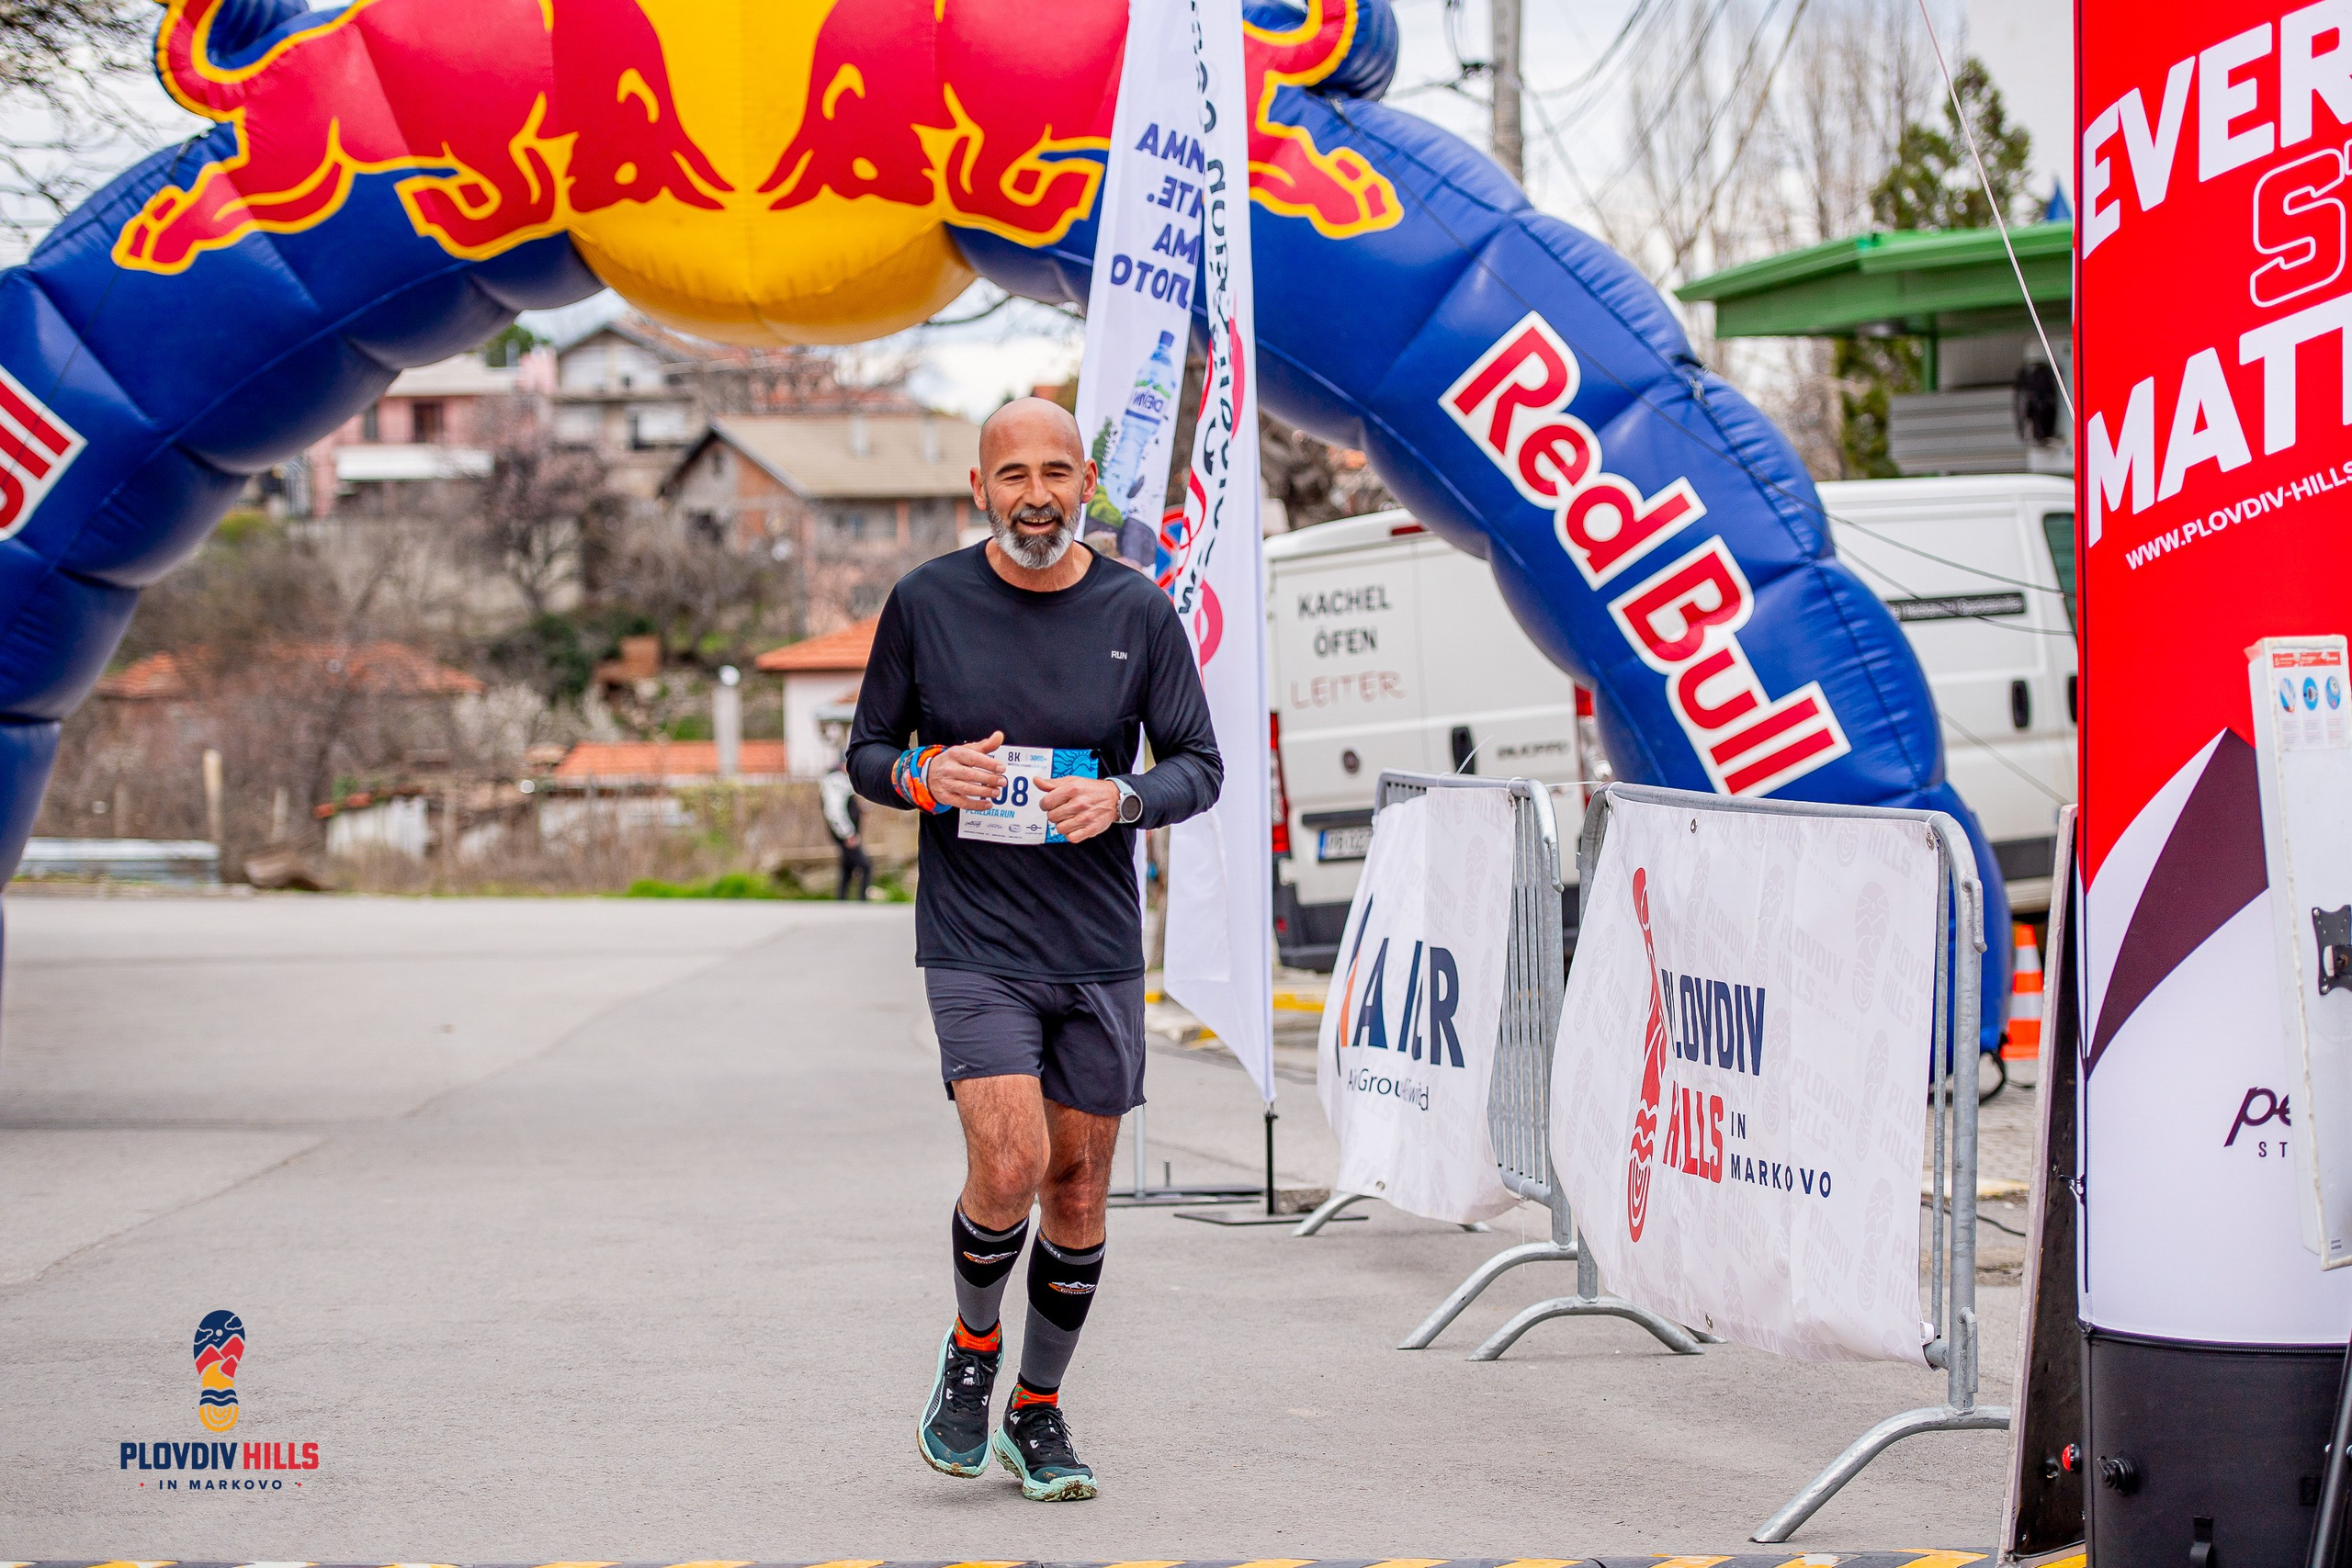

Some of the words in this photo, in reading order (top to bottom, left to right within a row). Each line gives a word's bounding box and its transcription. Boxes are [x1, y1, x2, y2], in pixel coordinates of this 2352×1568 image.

[2250, 139, 2352, 308] S
[1453, 325, 1691, 575] Red
[1621, 550, 1836, 795] Bull
[1298, 586, 1390, 618] KACHEL
[1111, 650, 1127, 660] RUN
[1315, 627, 1377, 658] ÖFEN
[1291, 670, 1407, 709] LEITER
[1007, 751, 1021, 761] 8K
[979, 774, 1028, 807] 08
[1000, 809, 1015, 818] RUN
[1661, 968, 1766, 1076] POVDIV
[1662, 1080, 1724, 1184] HLLS
[1731, 1111, 1746, 1139] IN
[1731, 1153, 1831, 1198] MARKOVO
